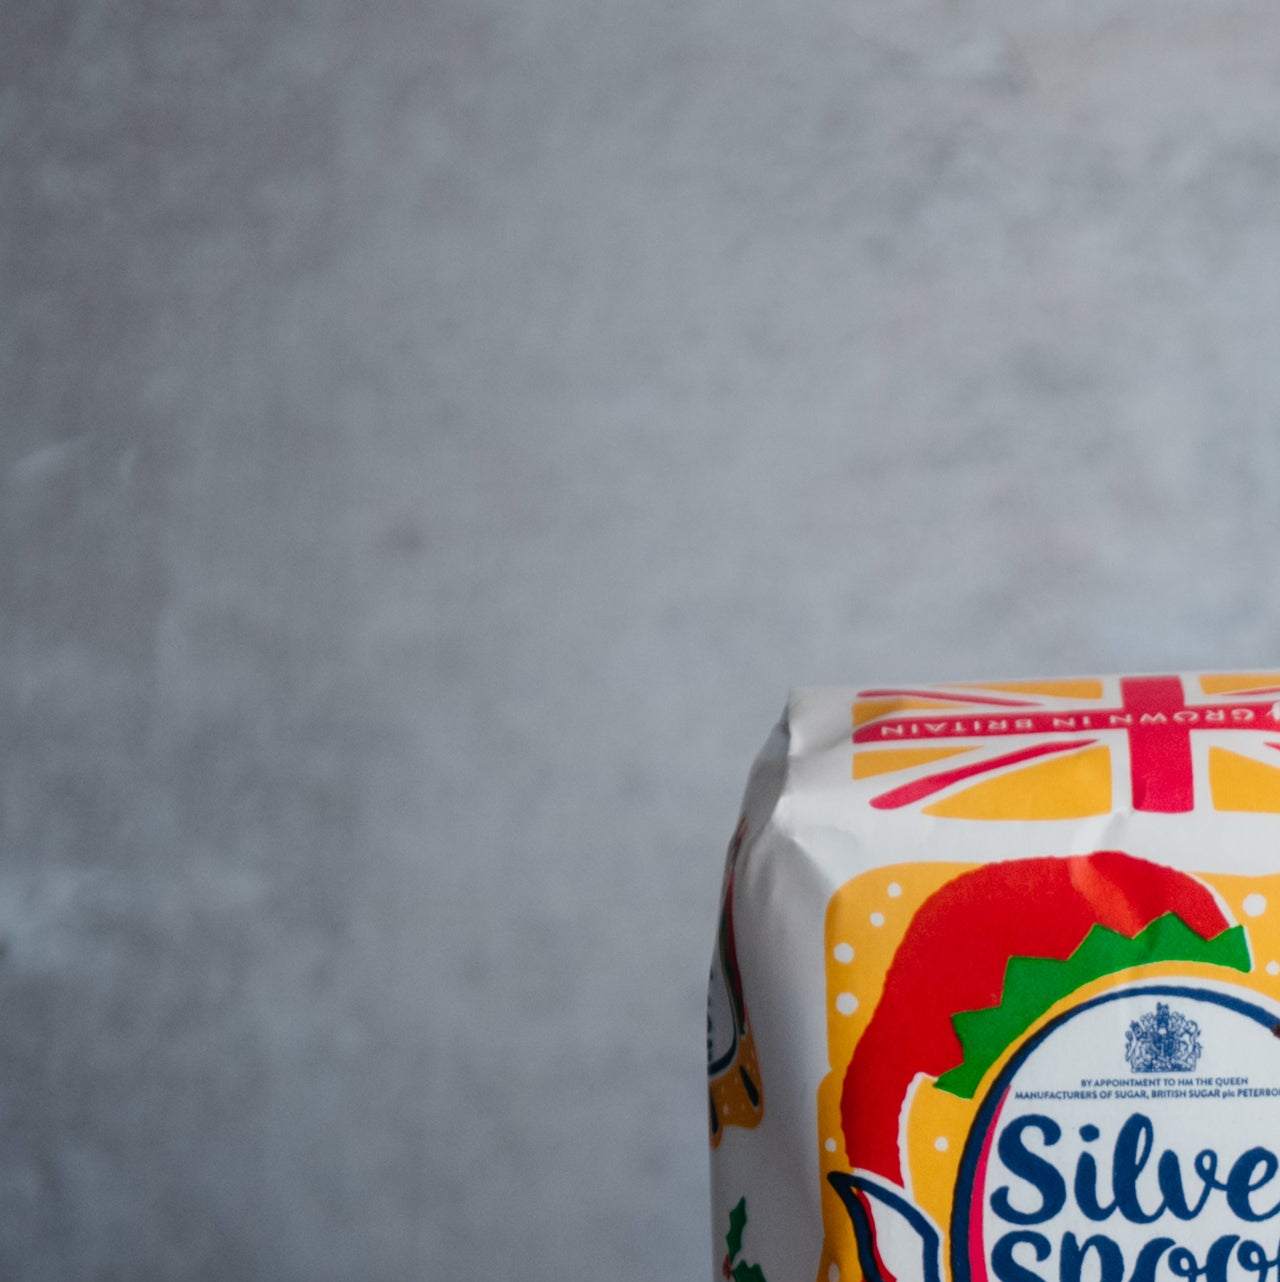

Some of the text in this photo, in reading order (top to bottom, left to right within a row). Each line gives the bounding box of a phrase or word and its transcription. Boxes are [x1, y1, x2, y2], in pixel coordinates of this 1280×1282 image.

[1109, 707, 1255, 724] GROWN
[881, 718, 1033, 736] BRITAIN
[1052, 716, 1091, 728] IN
[1081, 1077, 1249, 1088] BY APPOINTMENT TO HM THE QUEEN
[1015, 1090, 1098, 1100] MANUFACTURERS
[1100, 1090, 1112, 1099] OF
[1114, 1089, 1150, 1100] SUGAR,
[1151, 1089, 1187, 1099] BRITISH
[1188, 1089, 1220, 1099] SUGAR
[1222, 1089, 1236, 1099] plc
